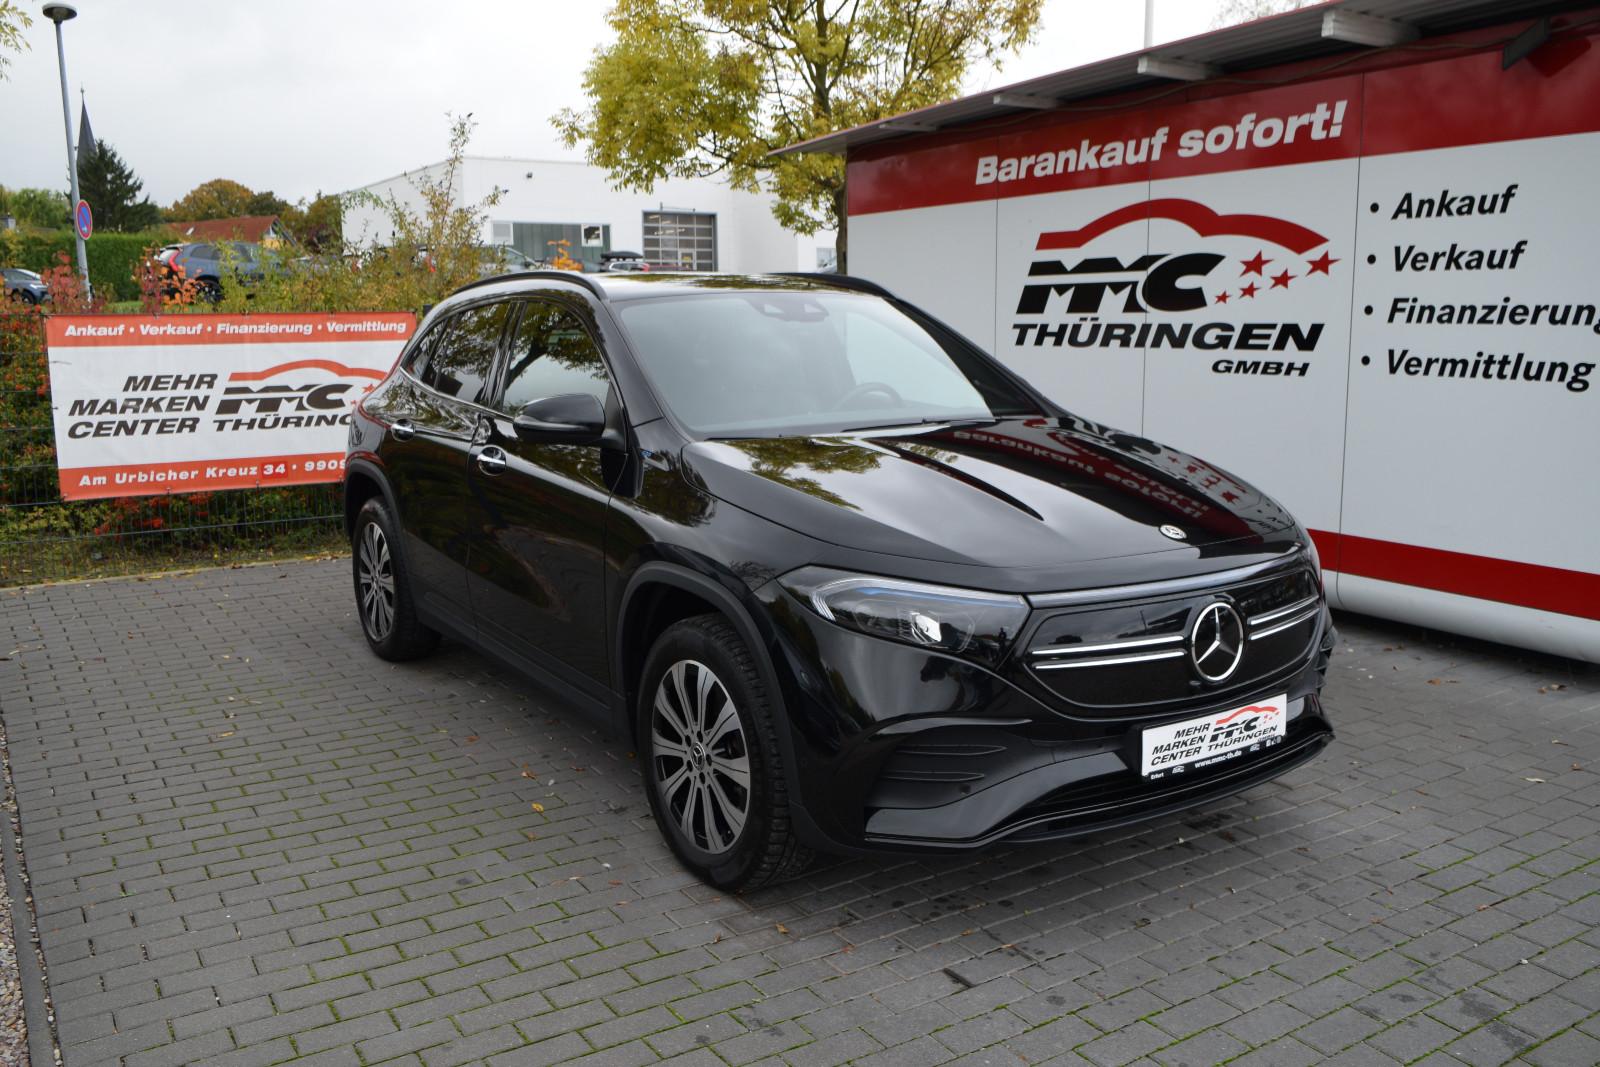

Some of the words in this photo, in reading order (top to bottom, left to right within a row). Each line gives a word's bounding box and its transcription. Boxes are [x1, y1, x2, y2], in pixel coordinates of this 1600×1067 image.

[975, 127, 1169, 185] Barankauf
[1177, 100, 1348, 158] sofort!
[1390, 184, 1519, 220] Ankauf
[1393, 240, 1528, 272] Verkauf
[65, 324, 125, 337] Ankauf
[140, 323, 203, 336] Verkauf
[216, 322, 313, 336] Finanzierung
[326, 320, 407, 333] Vermittlung
[1012, 317, 1325, 352] THÜRINGEN
[1210, 359, 1310, 377] GMBH
[1387, 349, 1596, 393] Vermittlung
[122, 373, 218, 392] MEHR
[68, 395, 210, 416] MARKEN
[68, 417, 200, 439] CENTER
[79, 475, 107, 486] Am
[115, 470, 199, 484] Urbicher
[206, 466, 258, 478] Kreuz
[263, 463, 286, 475] 34
[1174, 722, 1211, 740] MEHR
[1151, 746, 1202, 766] CENTER
[1208, 725, 1278, 752] THÜRINGEN
[1152, 734, 1207, 755] MARKEN
